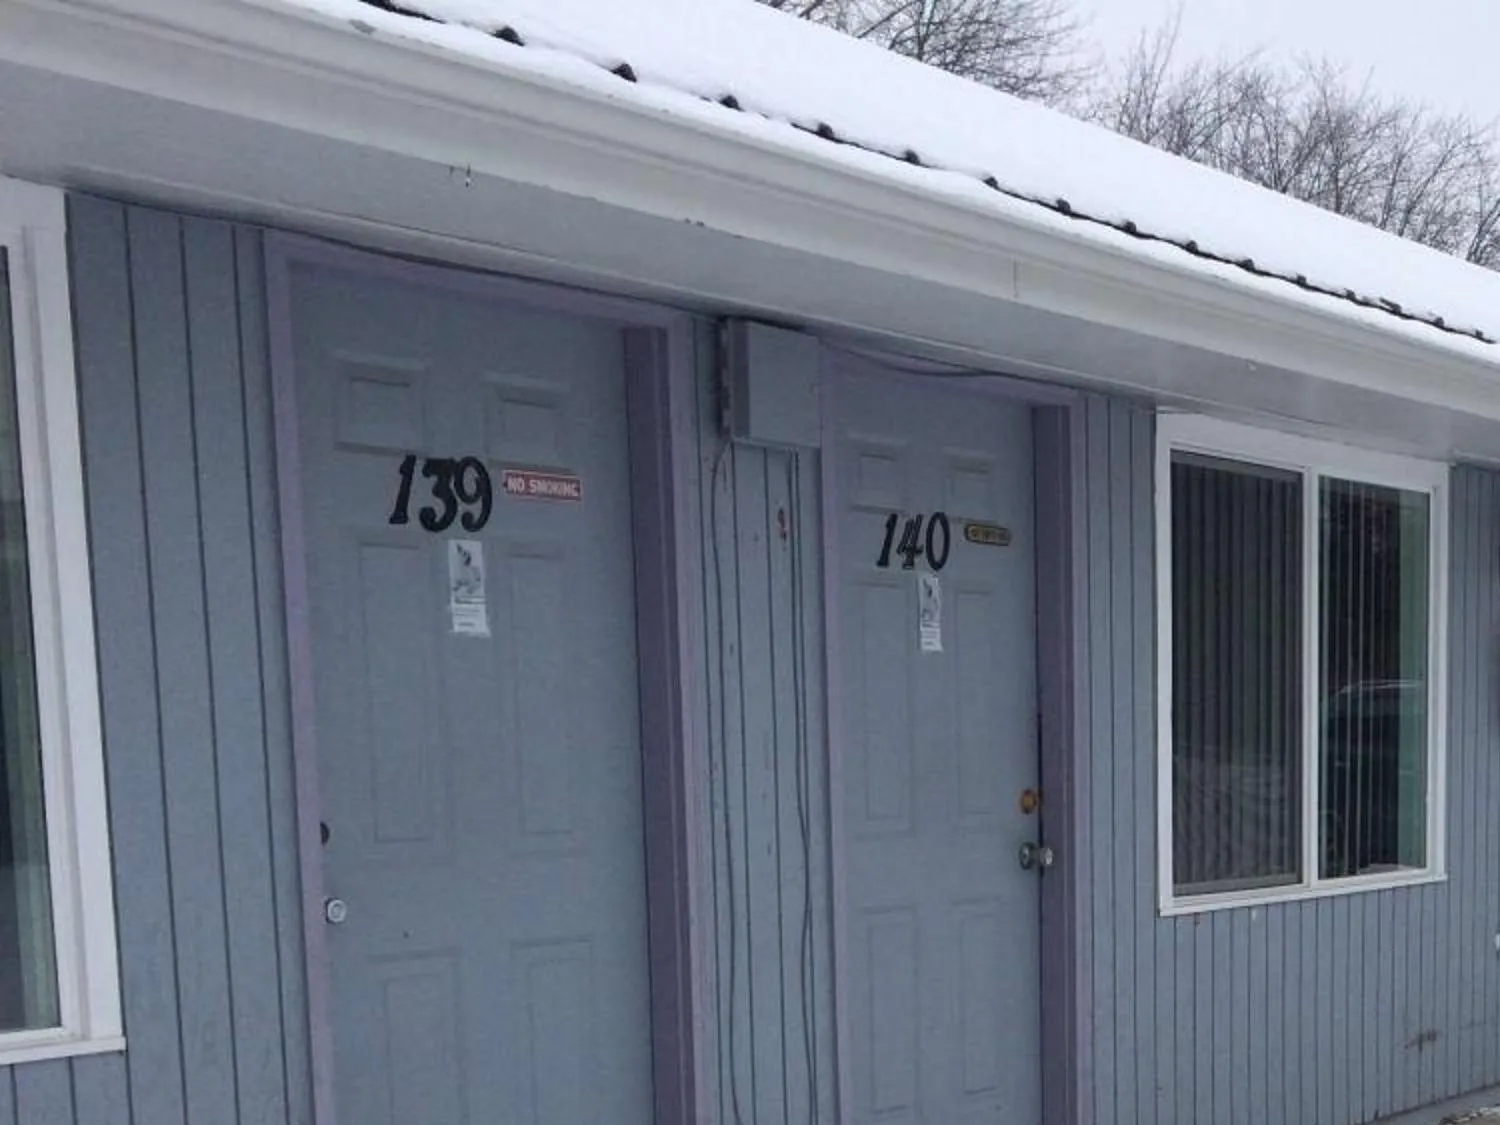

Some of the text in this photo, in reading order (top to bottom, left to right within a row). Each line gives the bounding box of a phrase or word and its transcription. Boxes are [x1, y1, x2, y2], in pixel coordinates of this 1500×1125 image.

[388, 454, 493, 533] 139
[507, 475, 579, 497] NO SMOKING
[876, 511, 950, 571] 140
